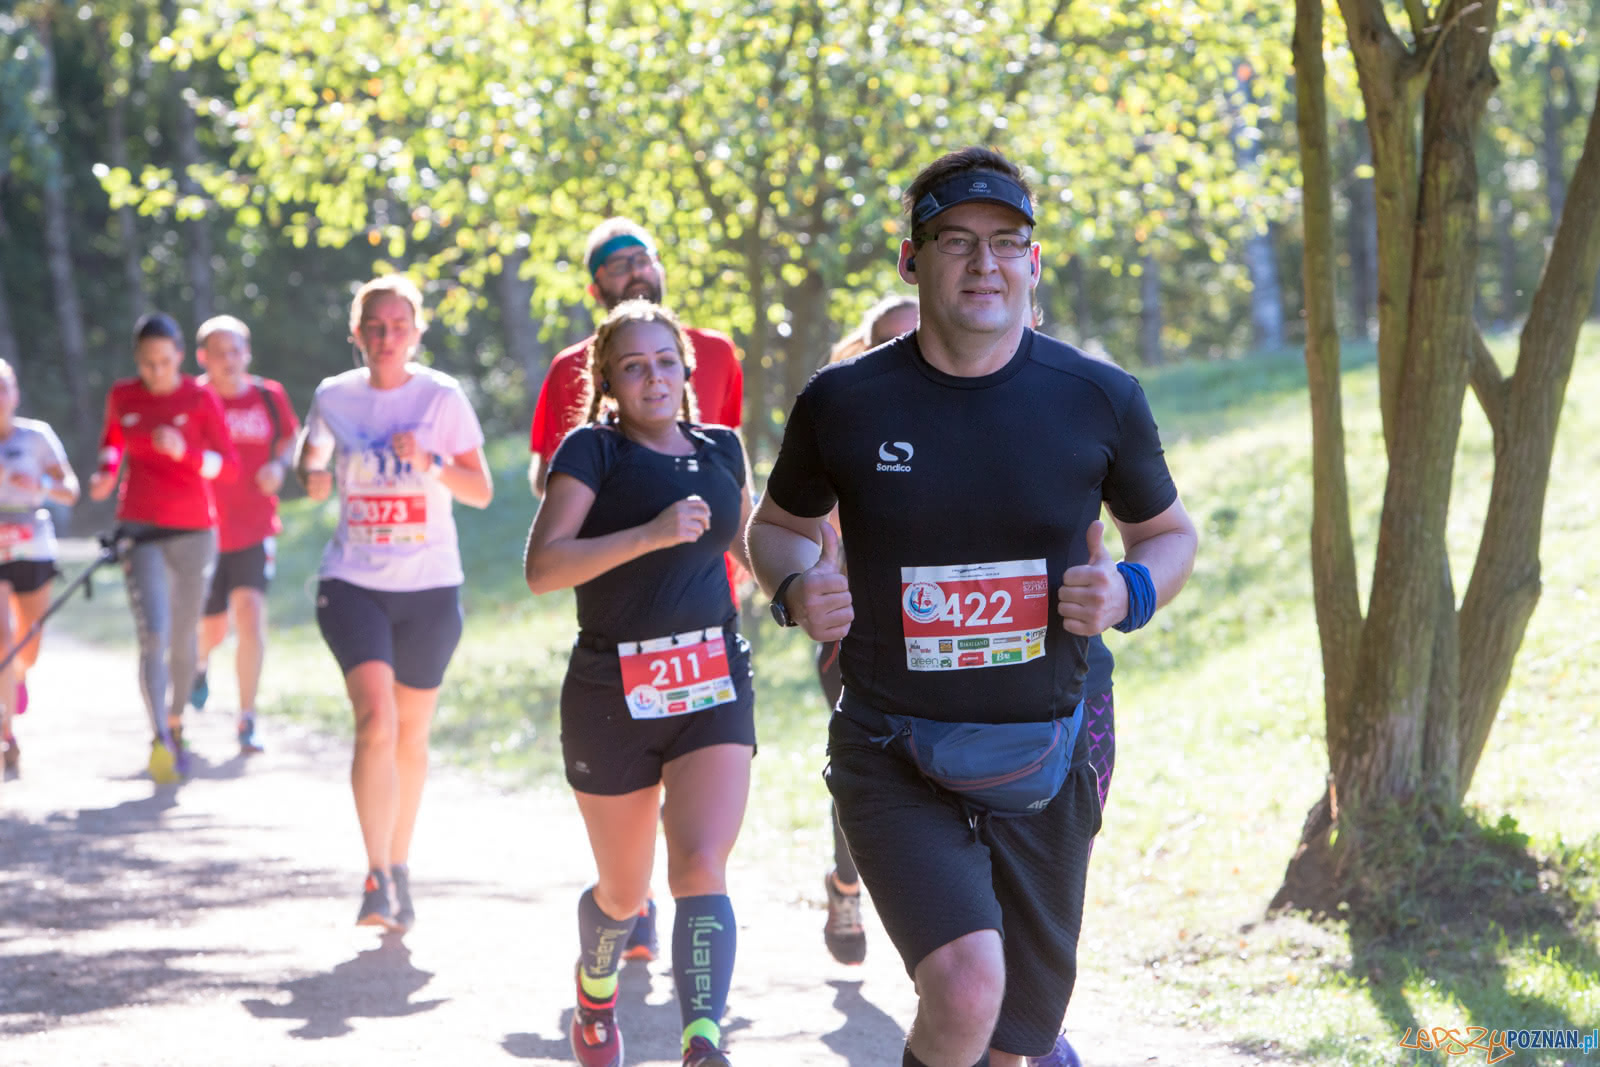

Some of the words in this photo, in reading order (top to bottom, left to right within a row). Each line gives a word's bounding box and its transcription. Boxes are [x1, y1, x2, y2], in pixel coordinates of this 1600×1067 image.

[876, 463, 912, 472] Sondico
[939, 590, 1013, 627] 422
[649, 653, 701, 686] 211
[911, 657, 939, 668] green
[685, 915, 723, 1011] kalenji
